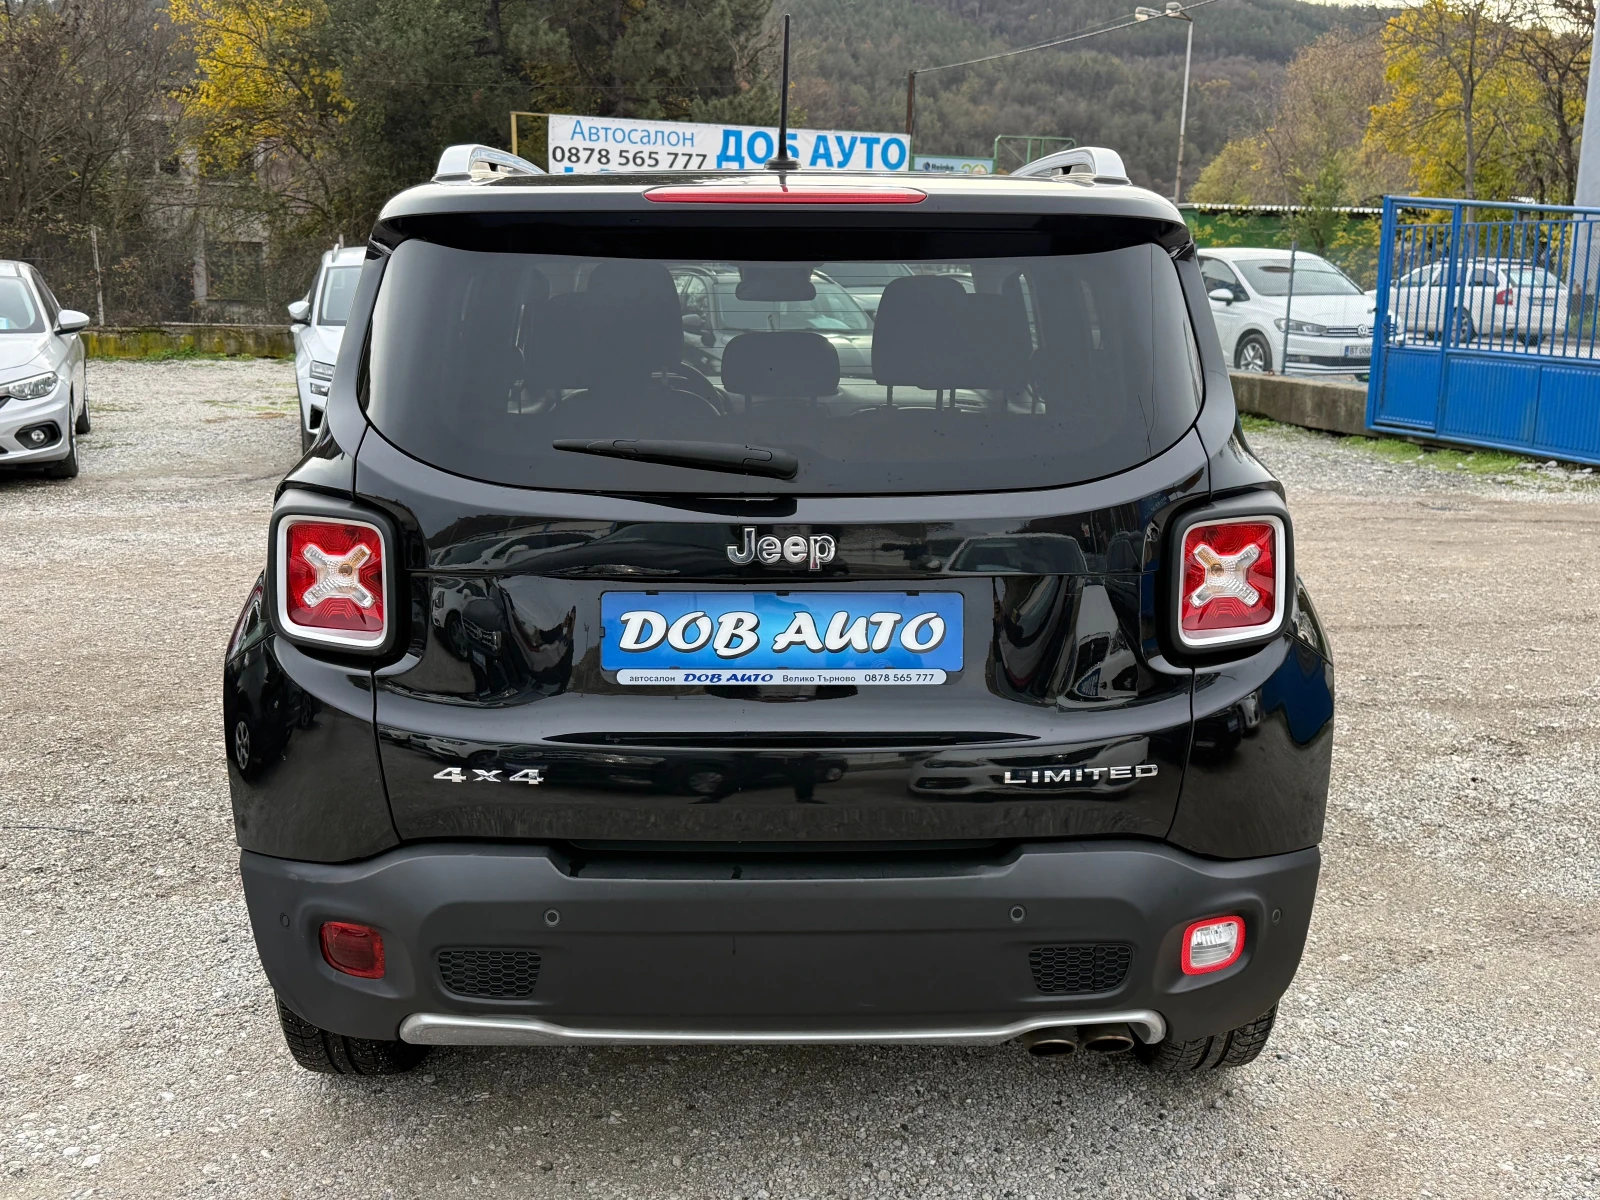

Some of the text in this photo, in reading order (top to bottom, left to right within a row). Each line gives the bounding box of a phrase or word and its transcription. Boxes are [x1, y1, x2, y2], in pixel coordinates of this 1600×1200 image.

[570, 119, 695, 147] Автосалон
[552, 145, 708, 170] 0878 565 777
[809, 135, 907, 170] АУТО
[726, 525, 837, 570] Jeep
[619, 611, 947, 659] DOB AUTO
[683, 673, 722, 683] DOB
[726, 673, 774, 683] AUTO
[782, 674, 815, 682] Велико
[817, 674, 857, 684] Търново
[864, 673, 890, 682] 0878
[893, 673, 912, 682] 565
[915, 673, 935, 682] 777
[1004, 764, 1159, 784] LIMITED
